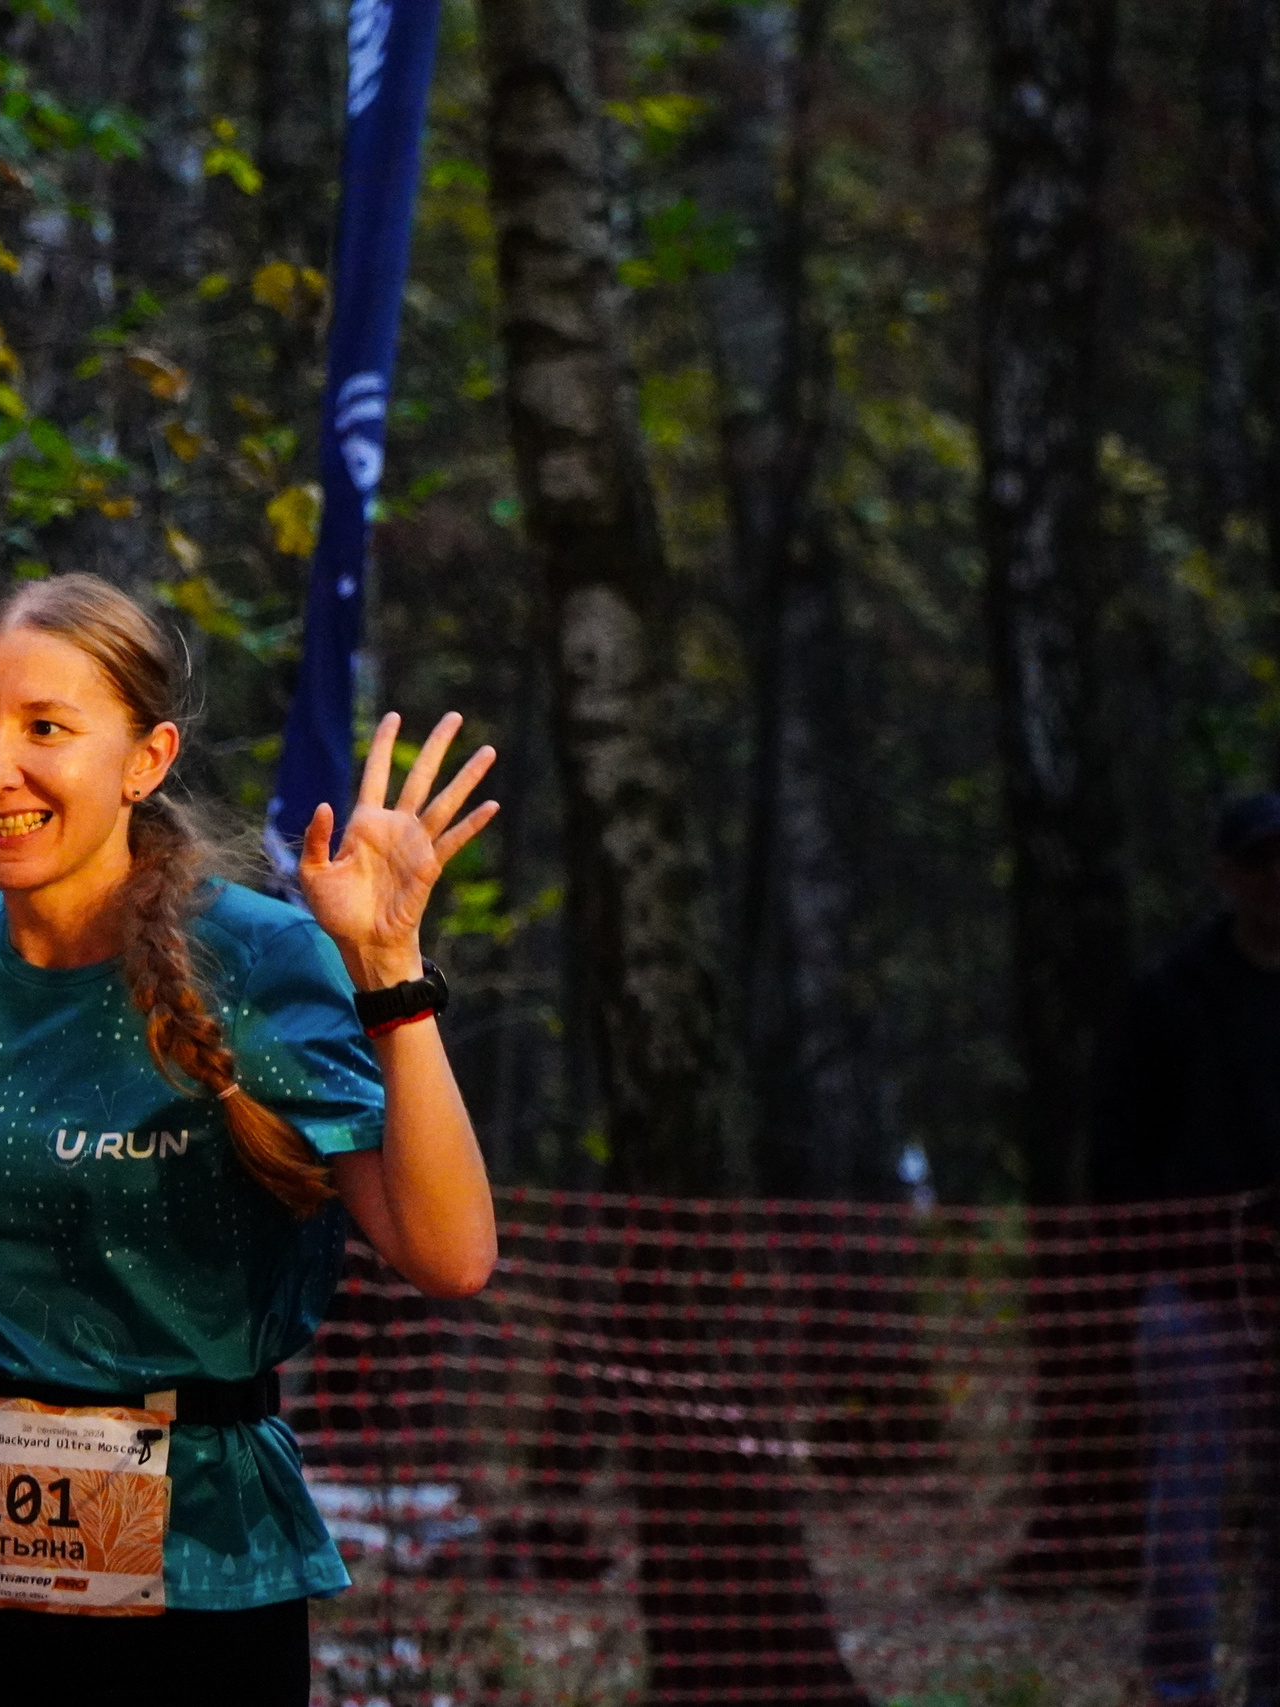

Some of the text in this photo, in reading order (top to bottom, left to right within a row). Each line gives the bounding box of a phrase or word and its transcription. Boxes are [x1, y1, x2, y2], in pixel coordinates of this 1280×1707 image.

[55, 1128, 189, 1160] U RUN
[83, 1429, 105, 1439] 2024
[56, 1439, 92, 1452] Ultra
